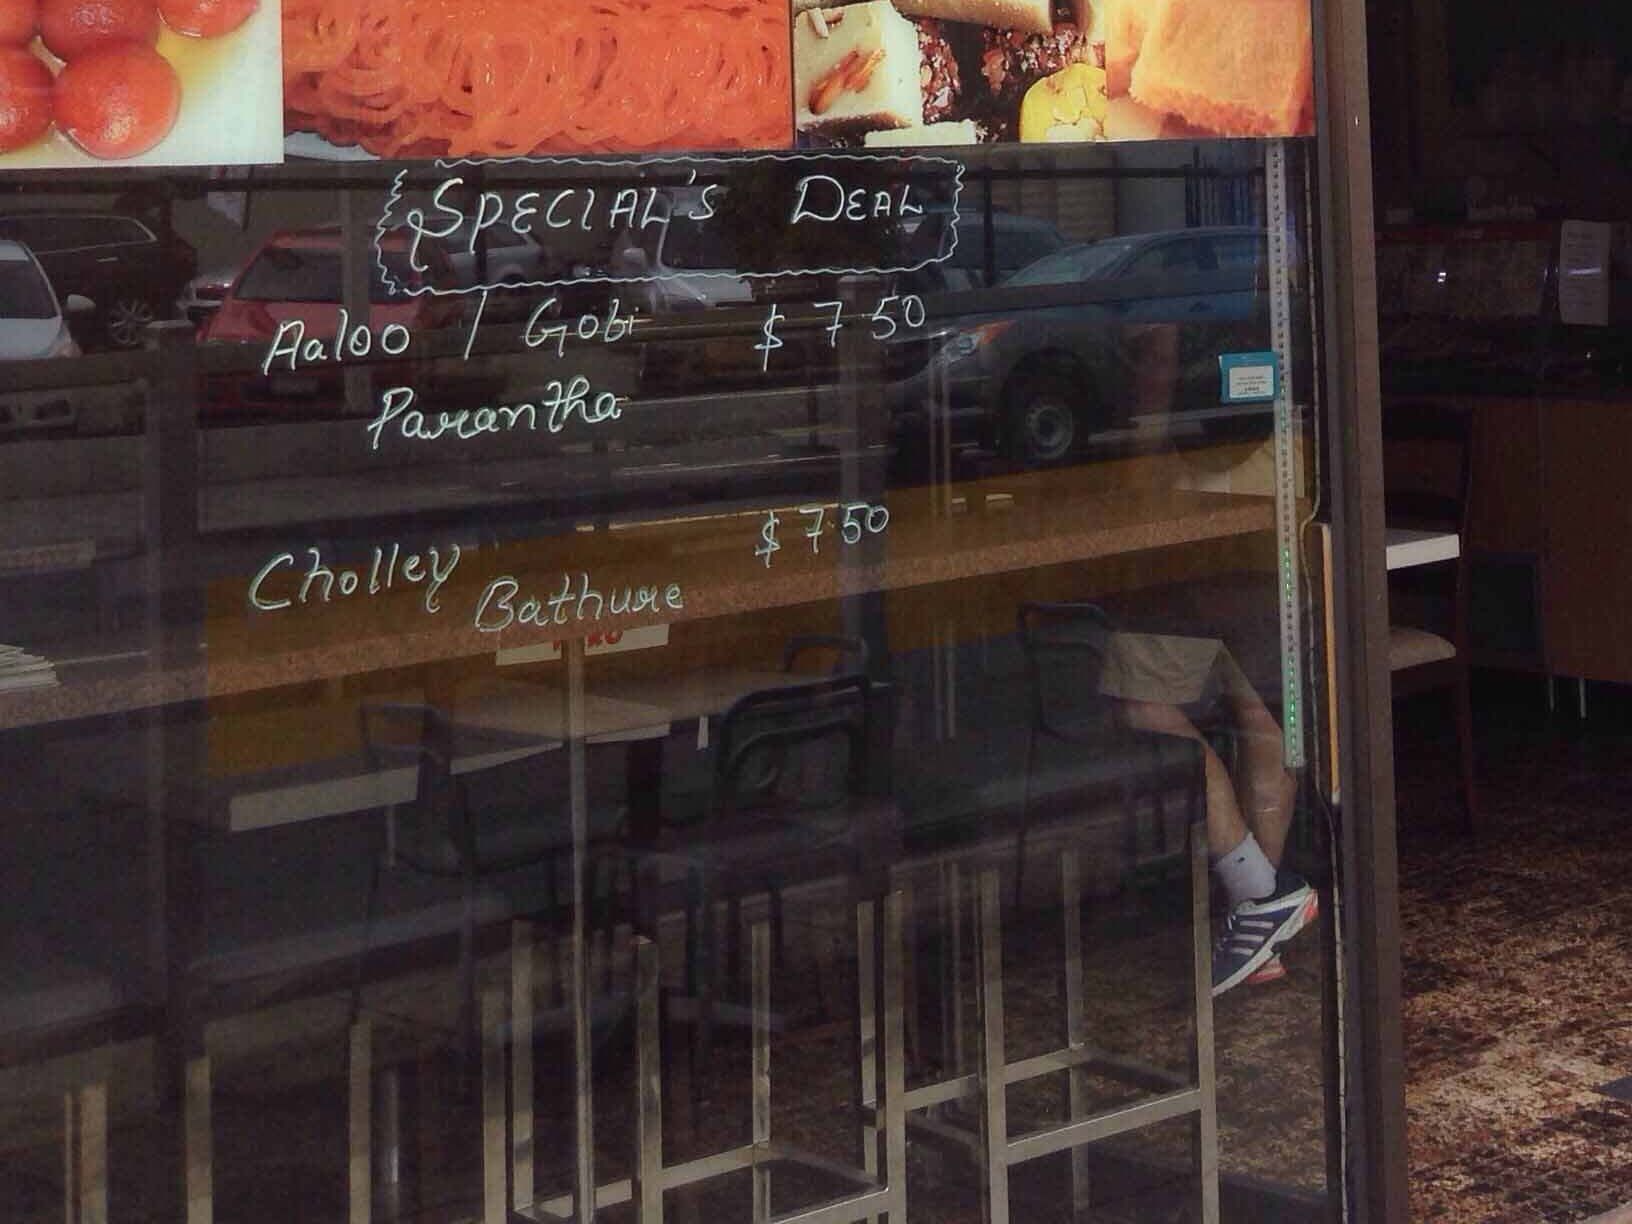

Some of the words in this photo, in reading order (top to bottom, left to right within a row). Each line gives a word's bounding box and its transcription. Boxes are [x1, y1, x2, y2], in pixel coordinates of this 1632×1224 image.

[263, 308, 411, 376] Aaloo
[524, 297, 640, 358] Gobi
[248, 543, 462, 614] Cholley
